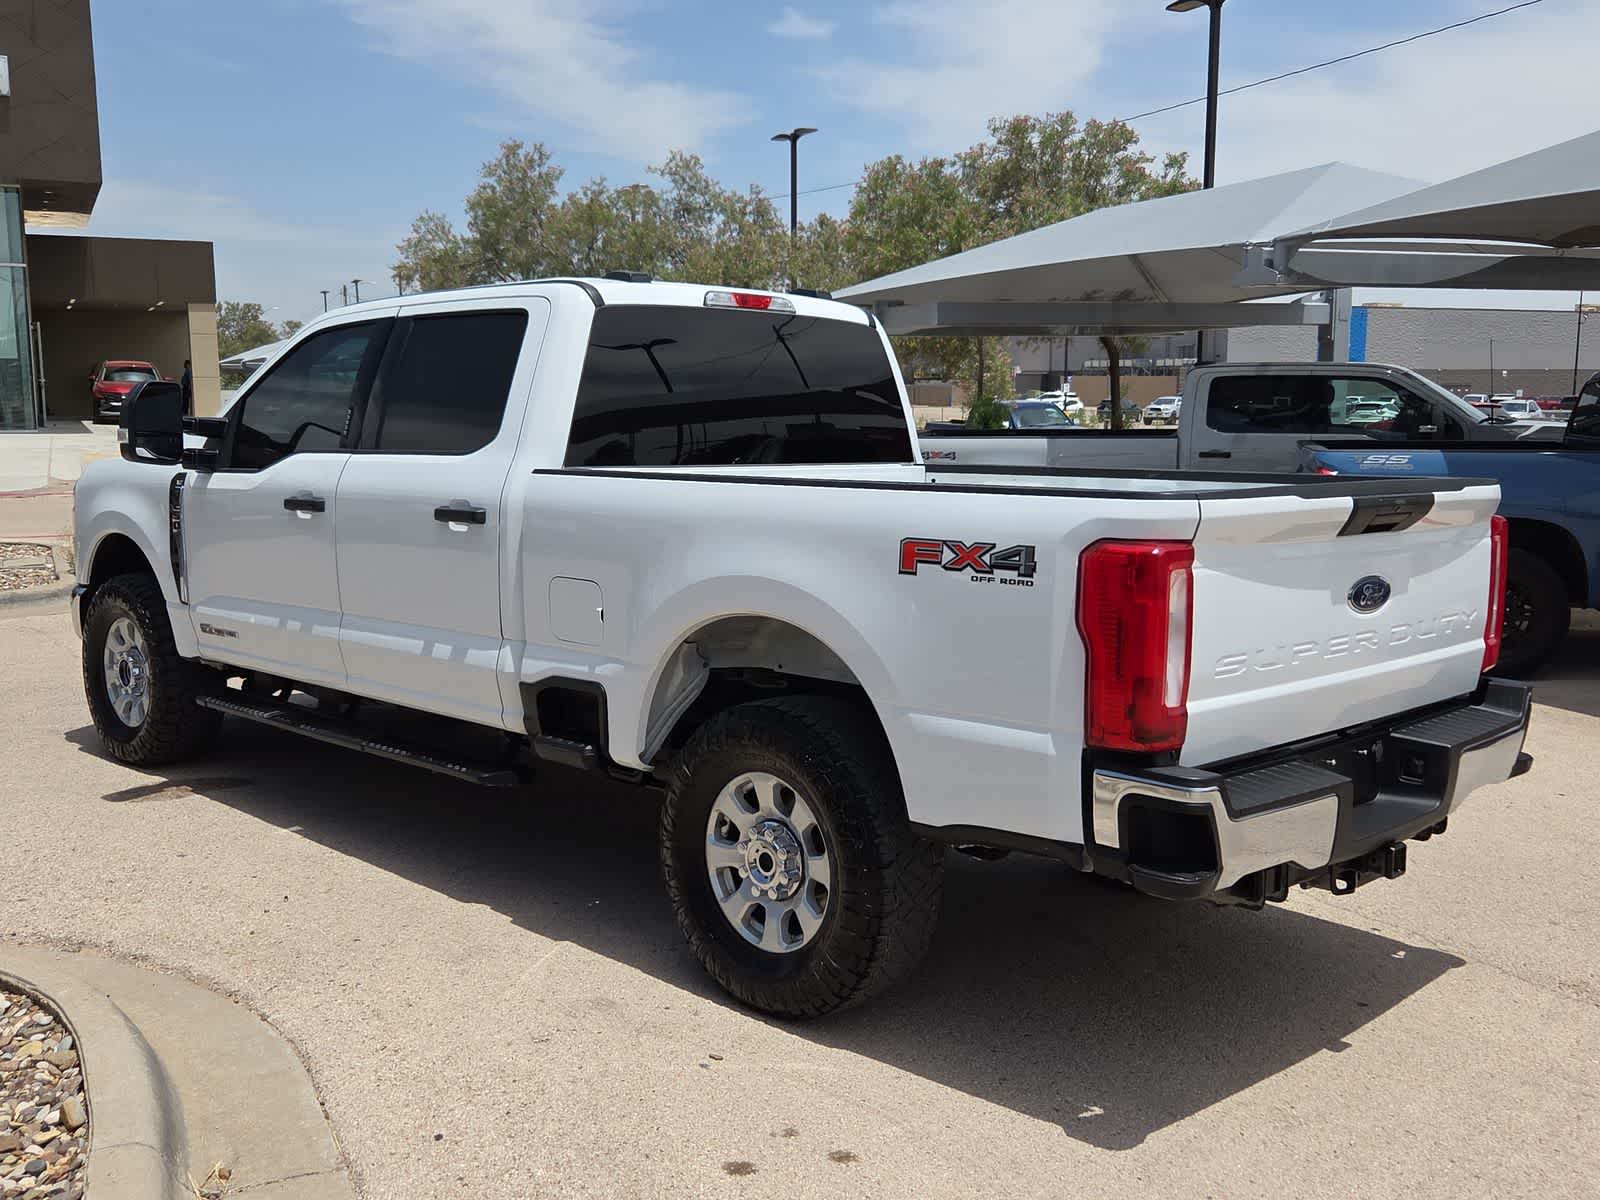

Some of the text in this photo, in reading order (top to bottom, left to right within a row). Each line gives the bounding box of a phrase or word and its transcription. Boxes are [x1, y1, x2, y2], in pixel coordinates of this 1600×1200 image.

[898, 536, 1037, 578] FX4
[970, 575, 1034, 587] OFF ROAD
[1213, 609, 1479, 679] SUPER DUTY
